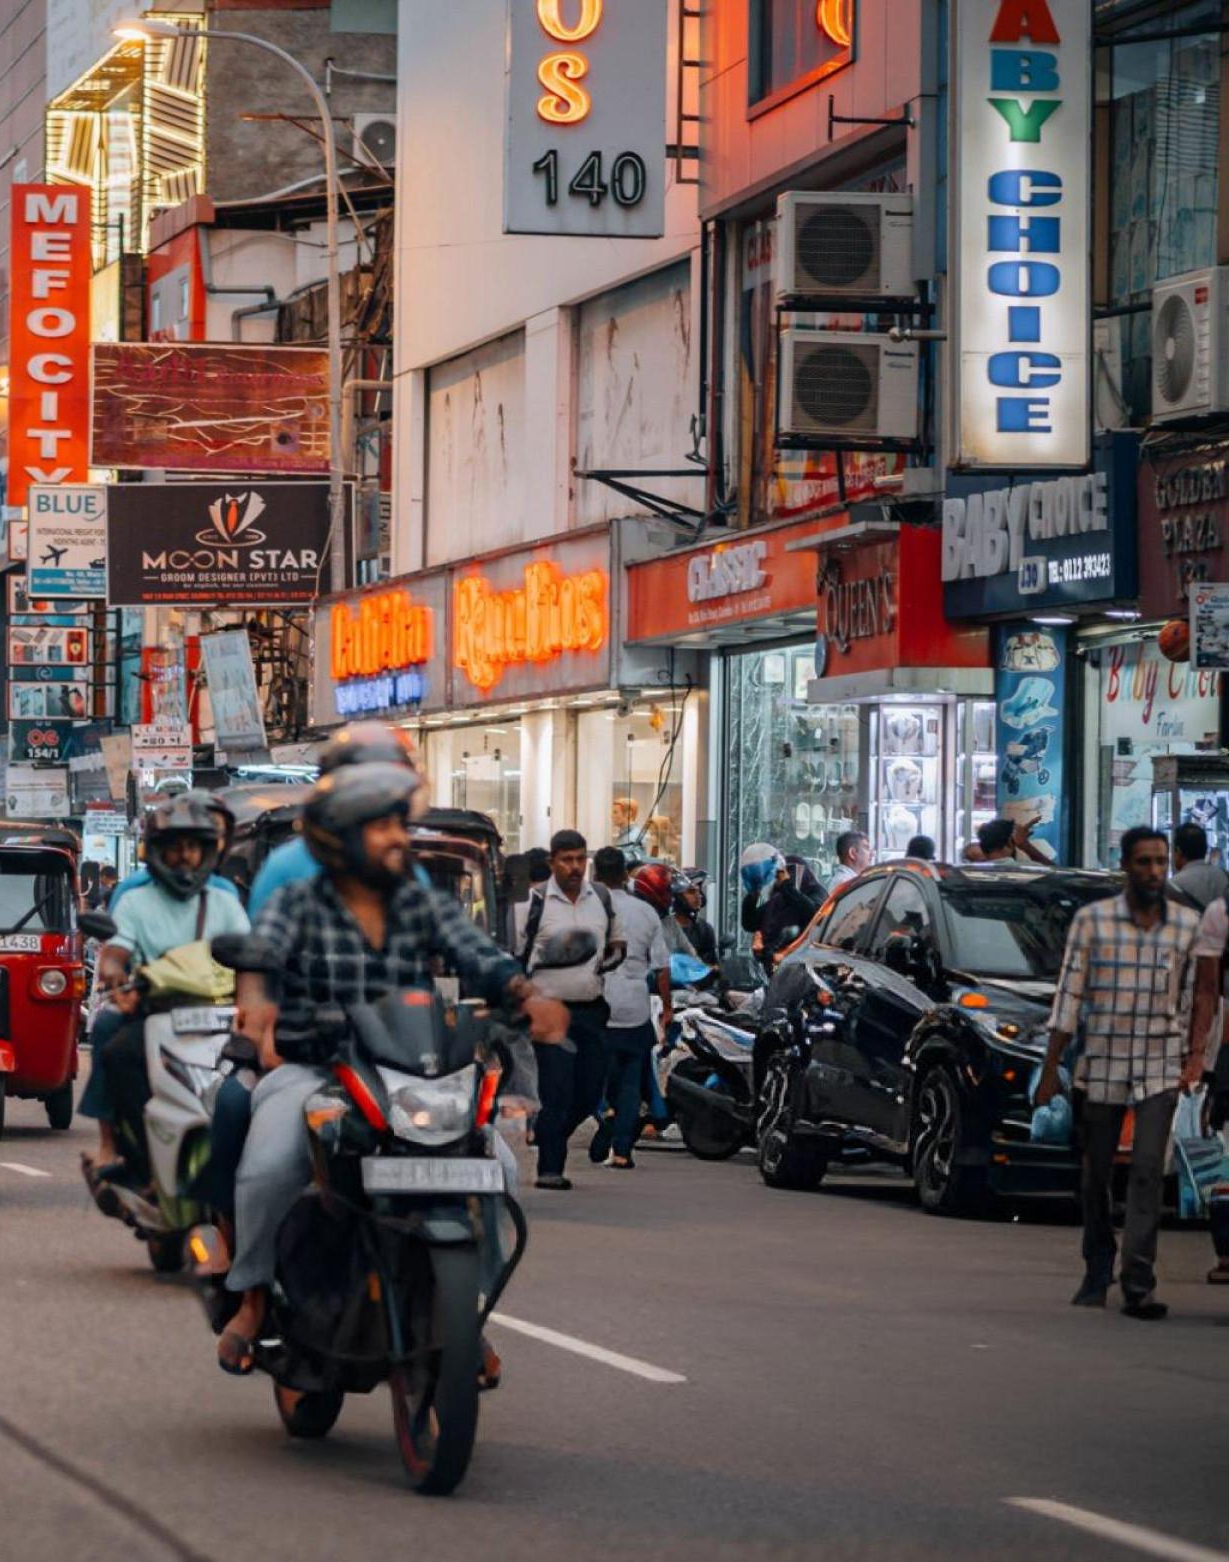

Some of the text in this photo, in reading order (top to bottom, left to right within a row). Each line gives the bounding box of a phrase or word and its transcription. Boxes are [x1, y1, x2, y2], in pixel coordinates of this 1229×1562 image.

[533, 149, 647, 209] 140
[987, 169, 1062, 434] CHOICE
[36, 494, 97, 514] BLUE
[941, 471, 1109, 582] BABY CHOICE
[142, 549, 319, 570] MOON STAR
[160, 573, 195, 583] GROOM
[198, 573, 247, 583] DESIGNER
[281, 573, 300, 583] LTD
[0, 935, 39, 949] 1438
